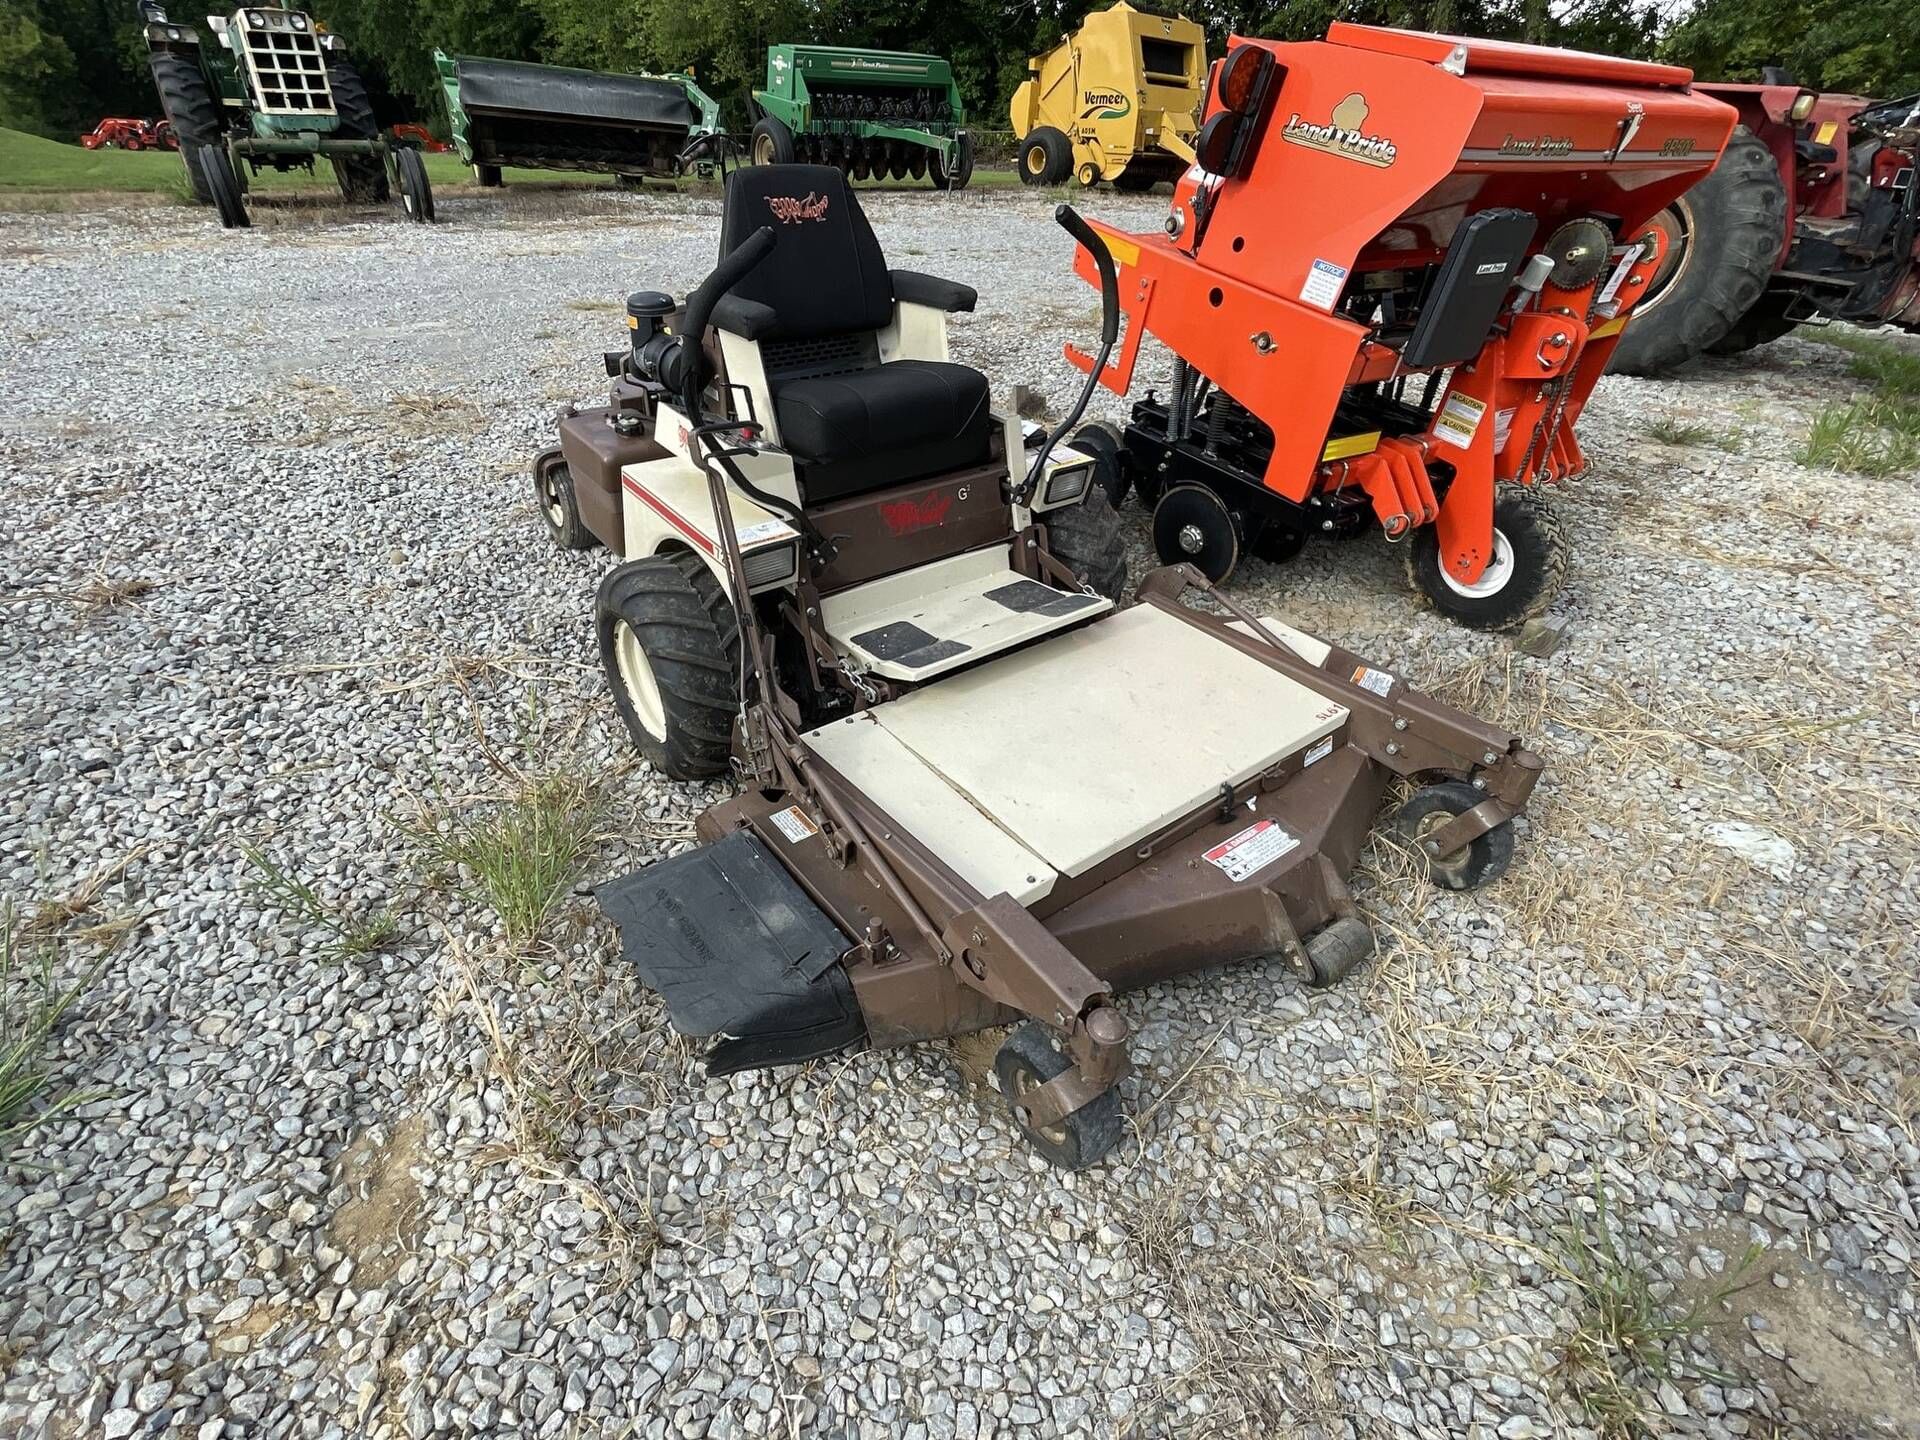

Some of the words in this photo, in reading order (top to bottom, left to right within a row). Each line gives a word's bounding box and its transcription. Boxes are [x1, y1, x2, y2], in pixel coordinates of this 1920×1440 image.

[1084, 91, 1124, 105] Vermeer
[1285, 113, 1337, 145] Land
[1342, 129, 1397, 161] Pride
[1499, 134, 1537, 155] Land
[1537, 134, 1574, 156] Pride
[1316, 262, 1344, 277] NOTICE
[1456, 394, 1484, 411] CAUTION
[1446, 419, 1472, 435] CAUTION
[1315, 703, 1345, 721] SL61
